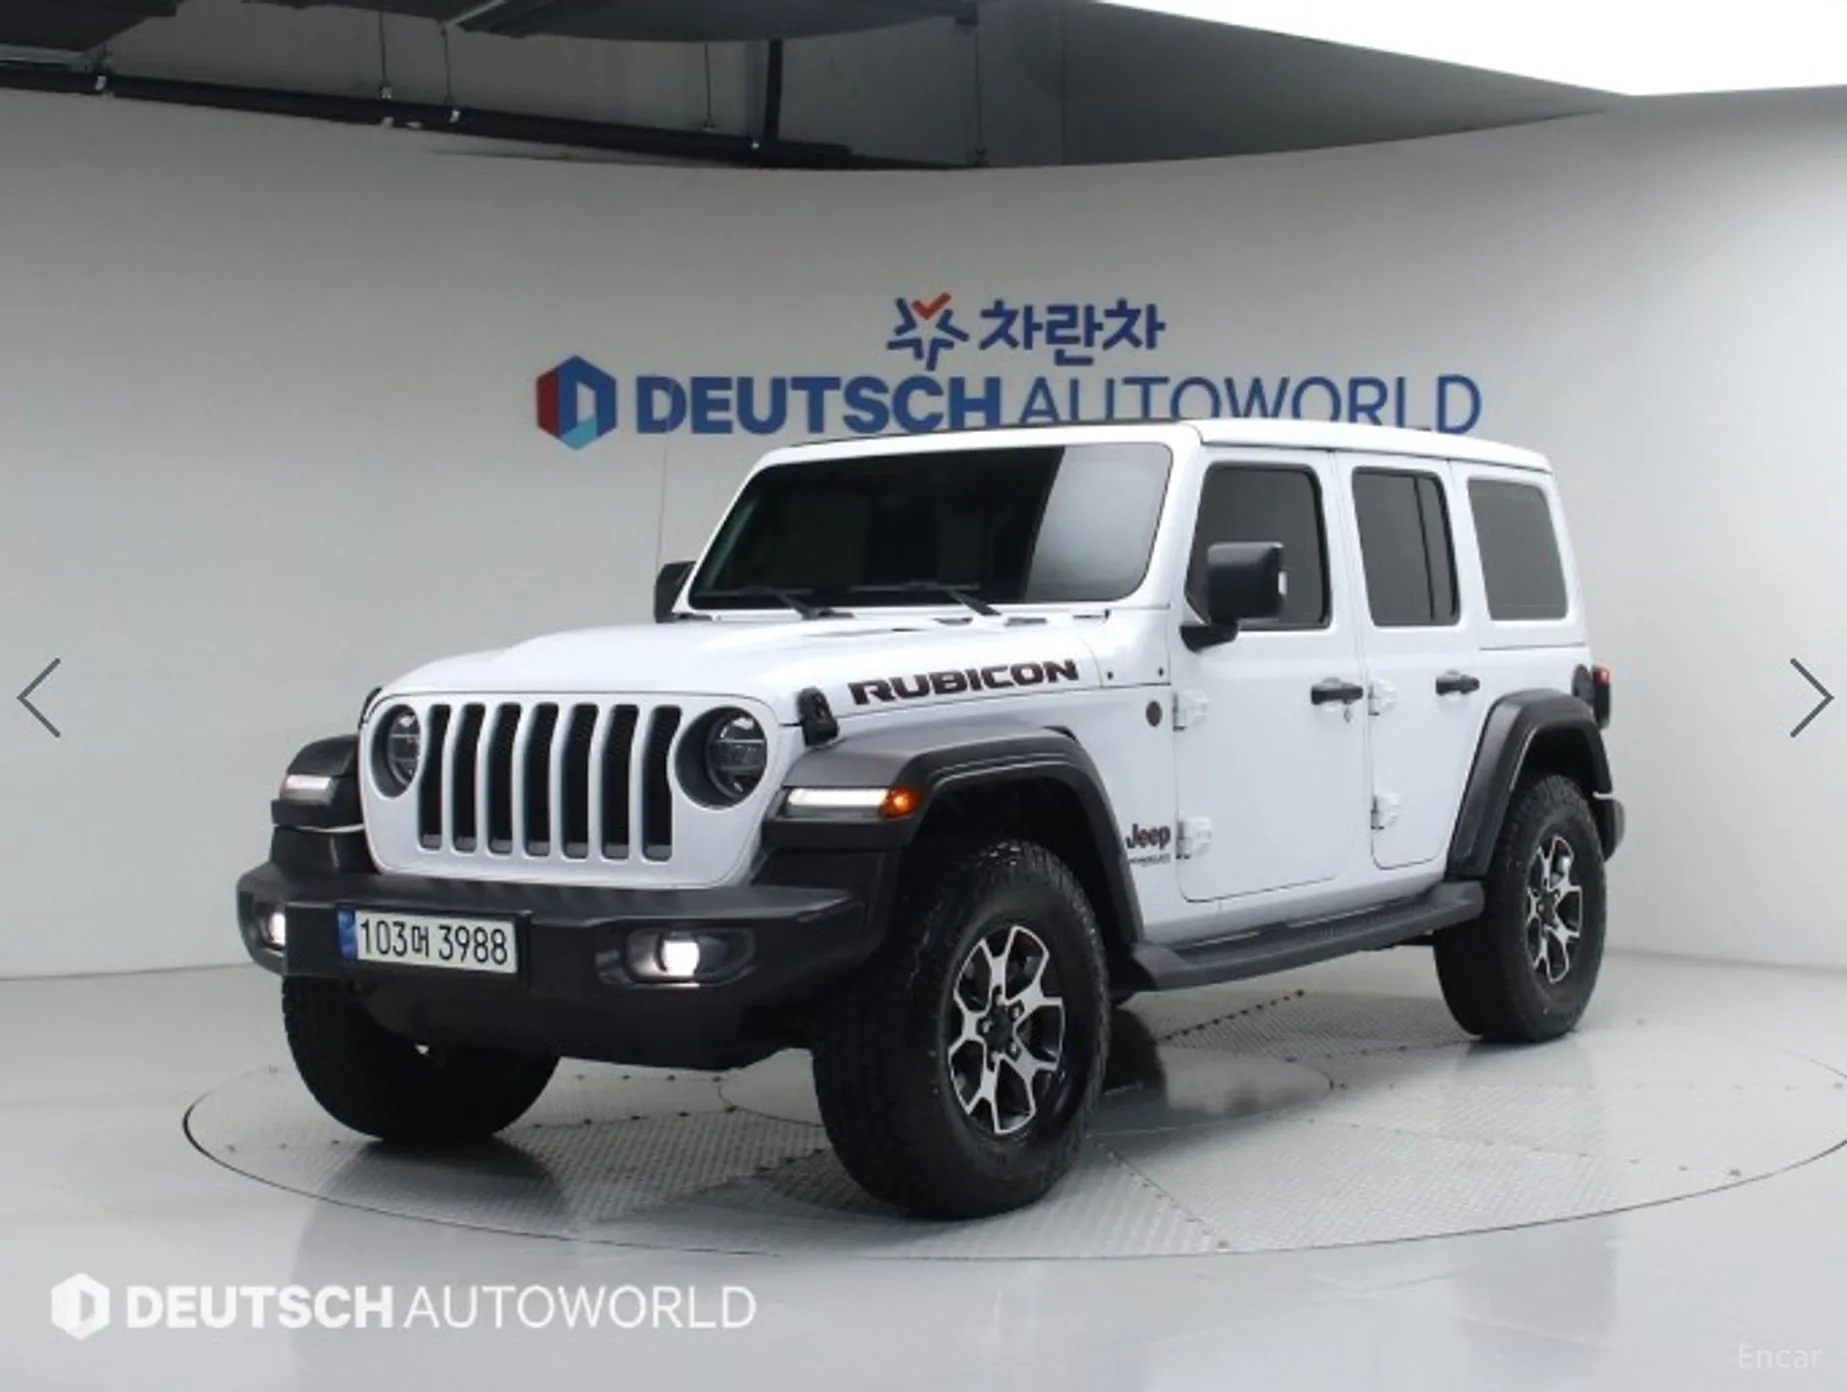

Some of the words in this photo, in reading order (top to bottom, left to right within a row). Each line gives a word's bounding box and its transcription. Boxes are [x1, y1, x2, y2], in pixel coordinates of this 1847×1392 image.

[979, 299, 1166, 366] 차란차
[635, 374, 1002, 434] DEUTSCH
[1019, 373, 1482, 435] AUTOWORLD
[848, 658, 1079, 705] RUBICON
[1125, 822, 1171, 850] Jeep
[438, 924, 508, 965] 3988
